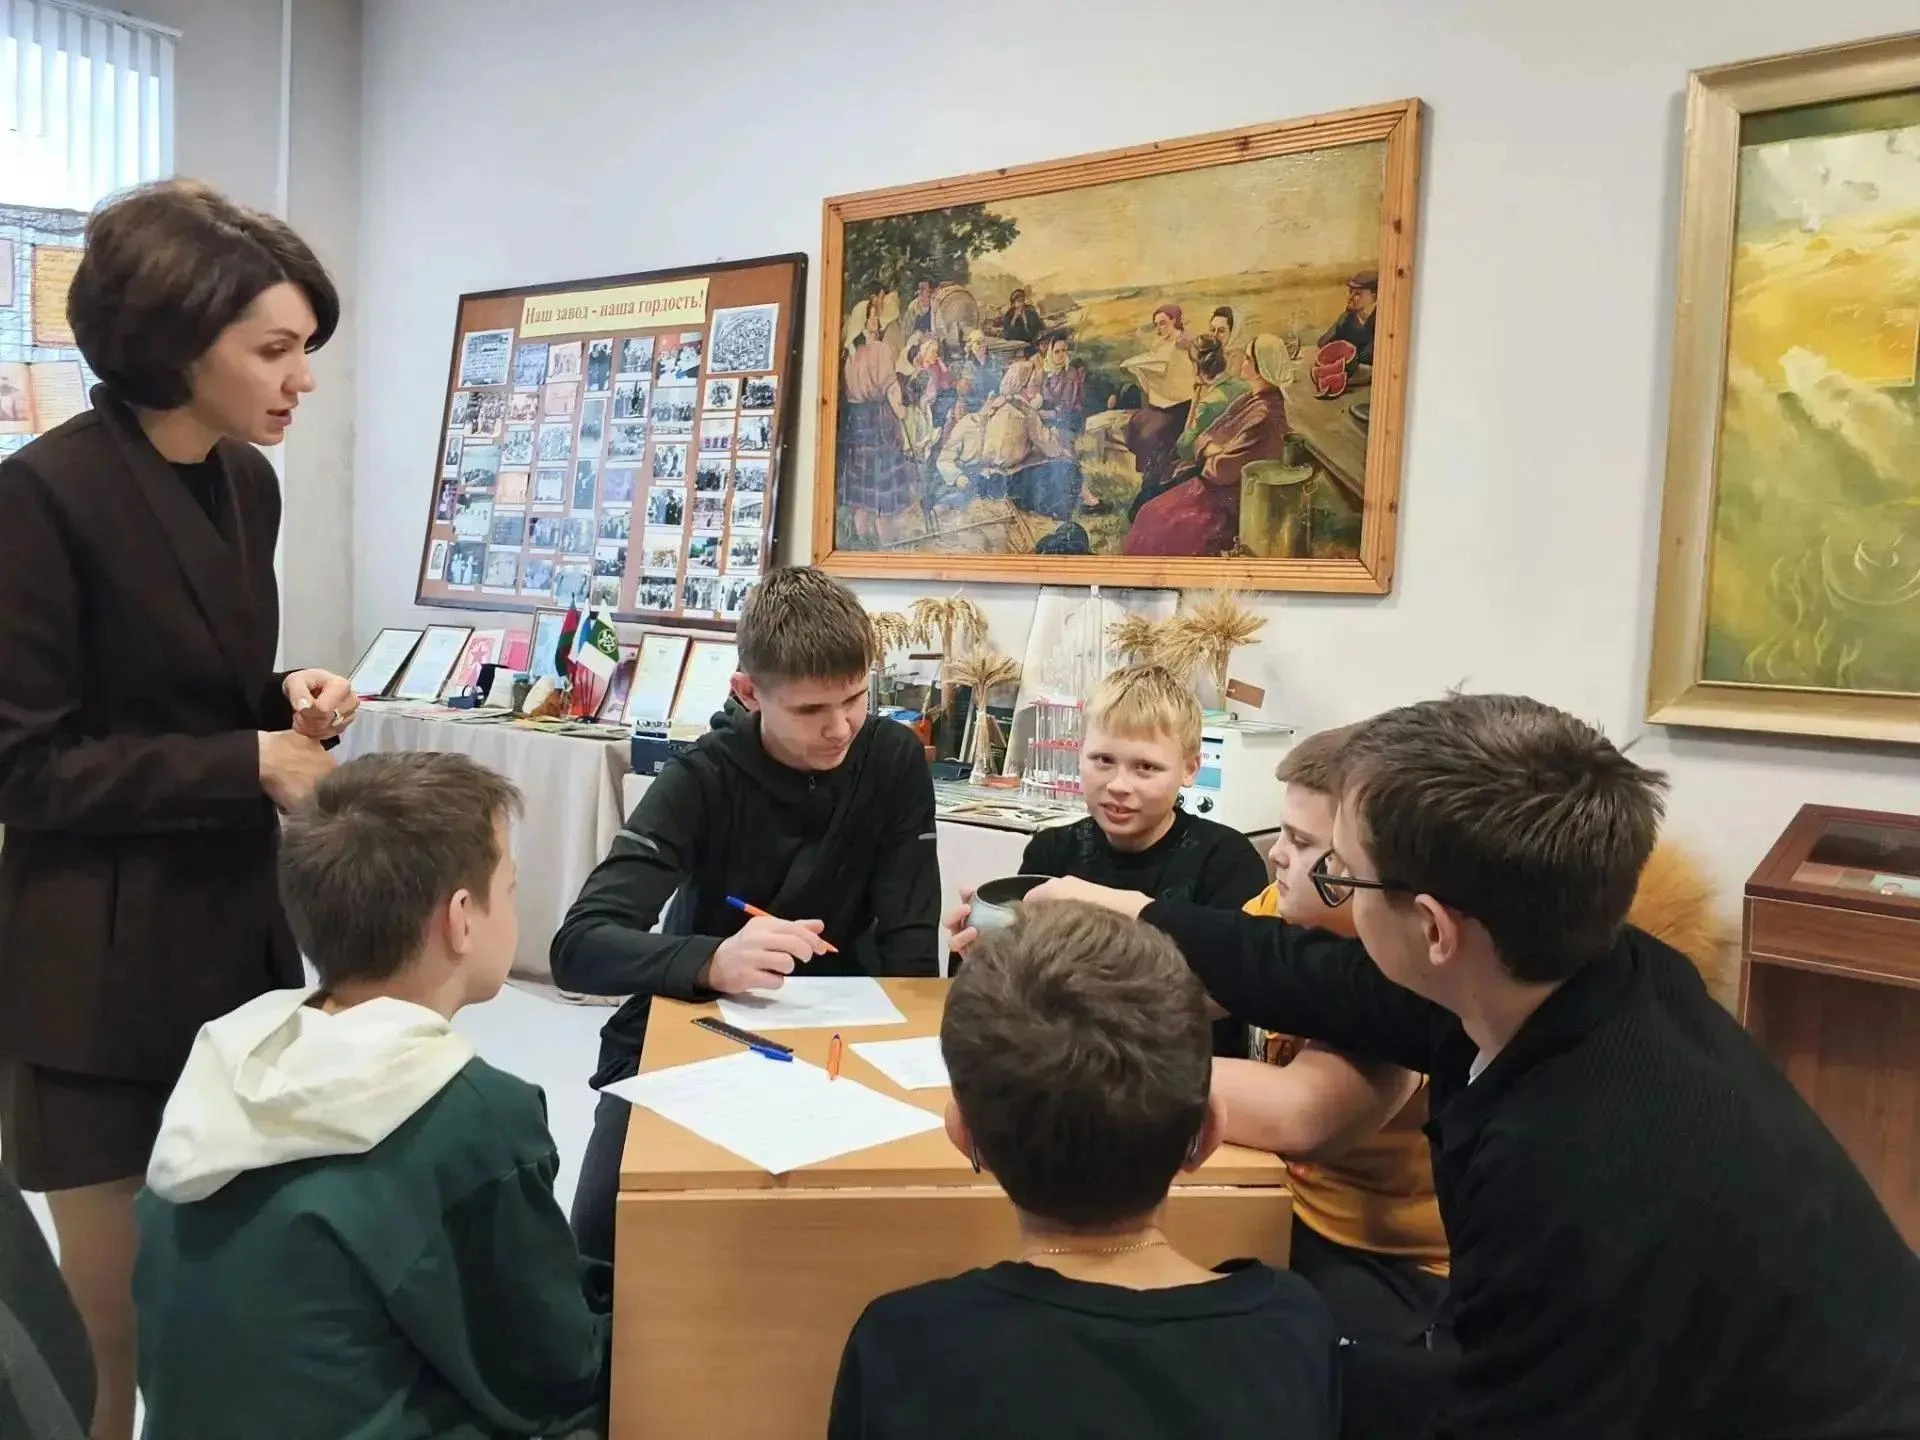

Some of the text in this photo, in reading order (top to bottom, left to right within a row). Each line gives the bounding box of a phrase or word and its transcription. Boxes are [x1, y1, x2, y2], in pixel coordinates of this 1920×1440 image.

[525, 307, 552, 324] Наш
[554, 305, 588, 321] завод
[600, 301, 635, 317] наша
[638, 289, 704, 317] гордость!
